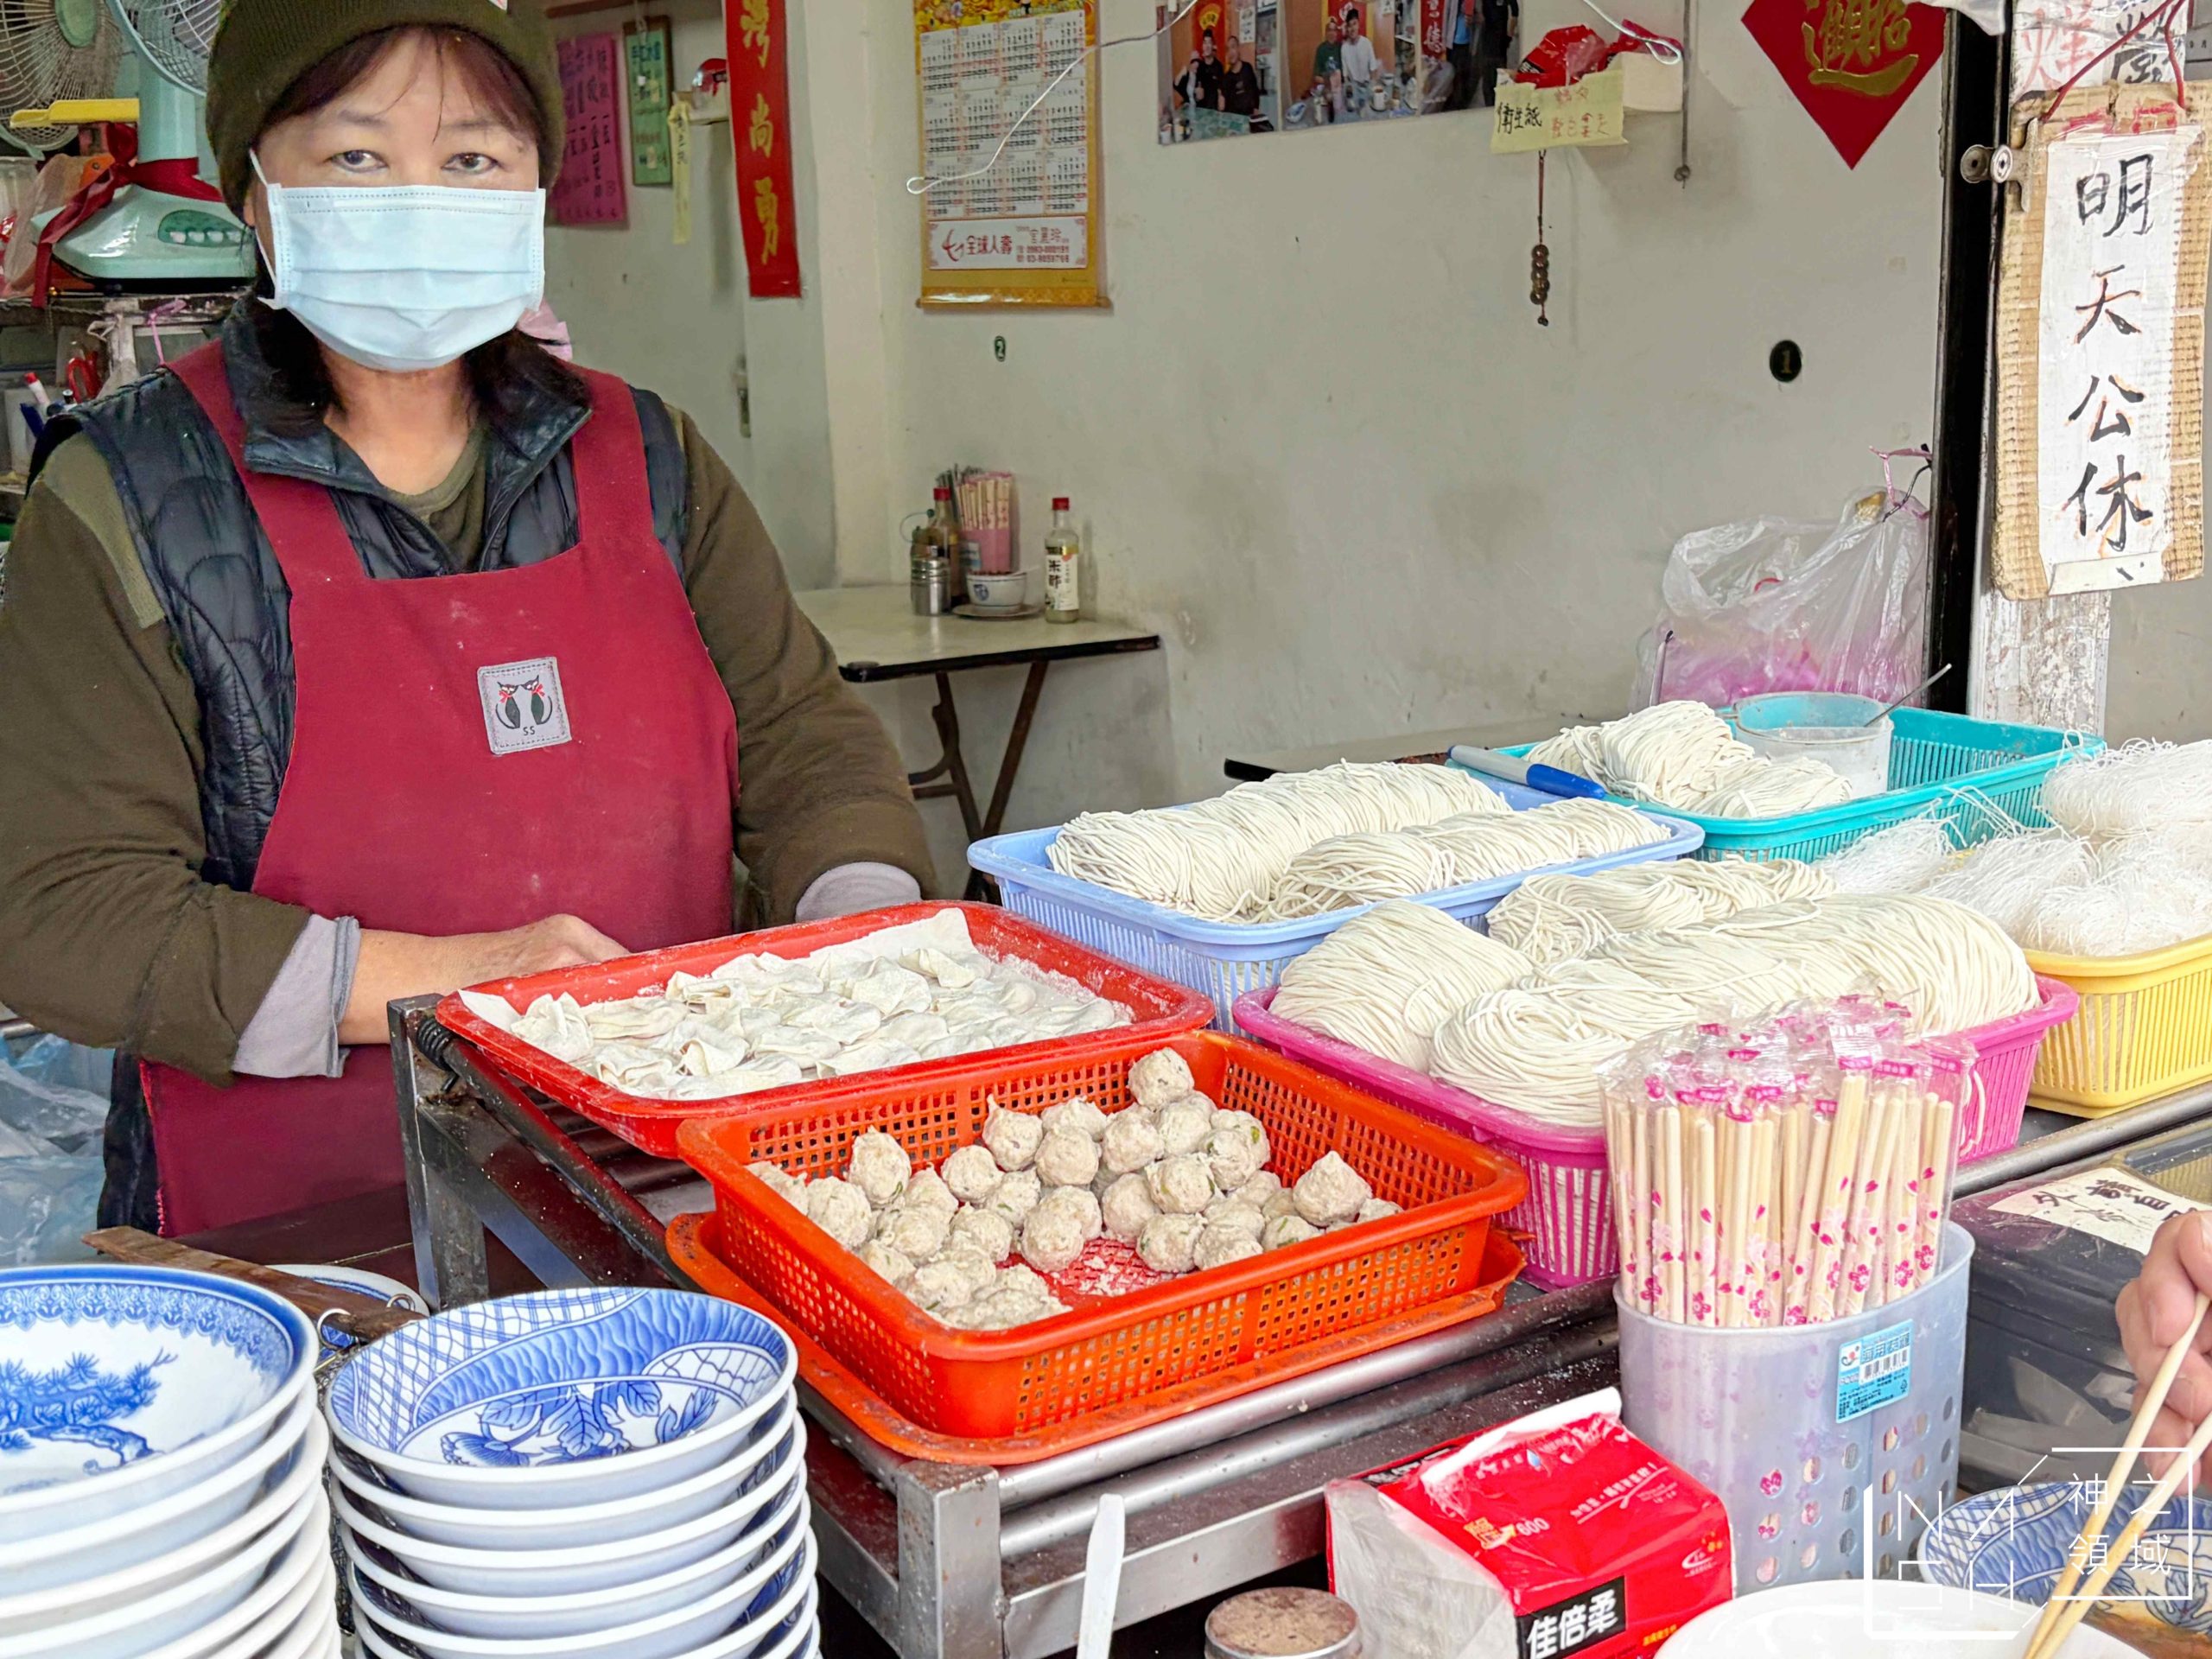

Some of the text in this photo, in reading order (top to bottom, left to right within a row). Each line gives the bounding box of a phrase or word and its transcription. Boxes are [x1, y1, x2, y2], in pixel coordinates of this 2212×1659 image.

[1496, 101, 1542, 135] 衛生紙
[965, 234, 1013, 256] 全球人壽
[2062, 153, 2154, 553] 明天公休
[1516, 1516, 1551, 1537] 600
[1527, 1587, 1619, 1659] 佳倍柔
